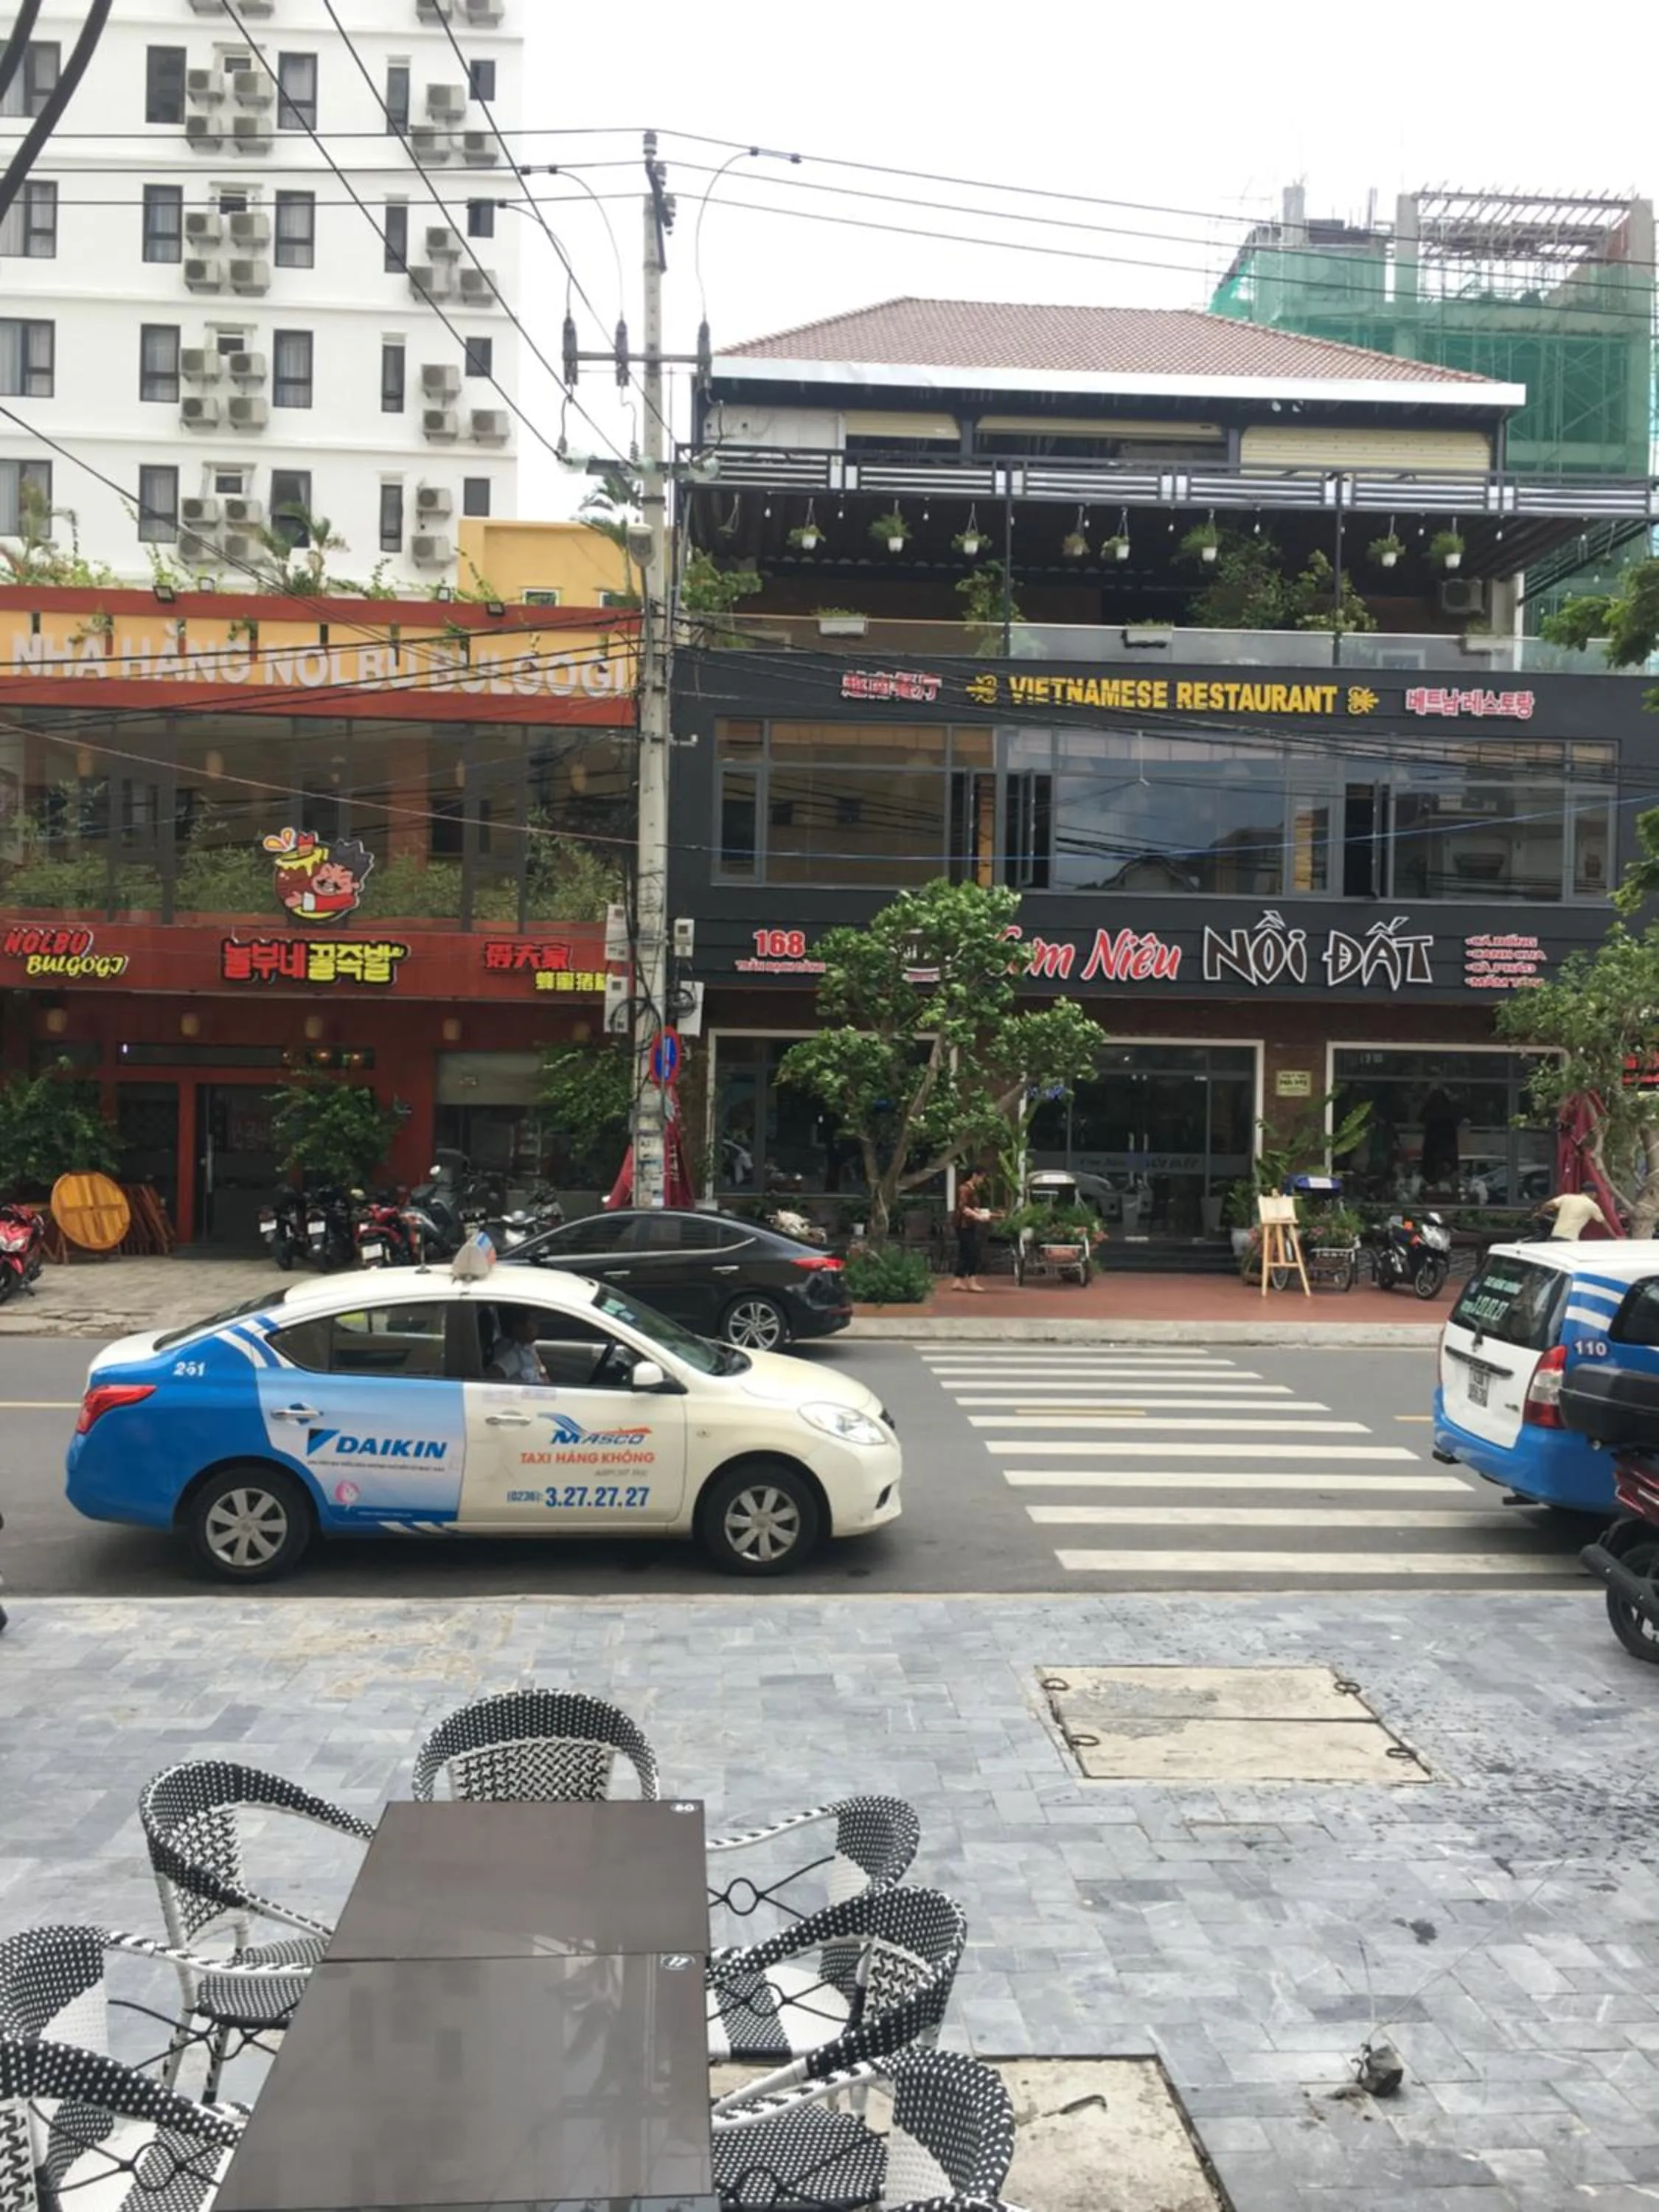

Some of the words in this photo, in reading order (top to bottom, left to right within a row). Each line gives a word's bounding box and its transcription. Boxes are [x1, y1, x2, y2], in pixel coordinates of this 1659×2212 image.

[263, 641, 415, 690] NOLBU
[429, 649, 630, 698] BULGOGI
[1009, 675, 1169, 709] VIETNAMESE
[1175, 681, 1338, 713] RESTAURANT
[3, 929, 91, 956] NOLBU
[752, 928, 806, 958] 168
[1080, 927, 1182, 981] Niêu
[1321, 917, 1433, 992] ĐẤT
[1573, 1339, 1608, 1357] 110
[335, 1435, 448, 1460] DAIKIN
[520, 1451, 552, 1464] TAXI
[555, 1449, 599, 1464] HÀNG
[600, 1449, 656, 1464] KHÔNG
[545, 1486, 650, 1508] 3.27.27.27
